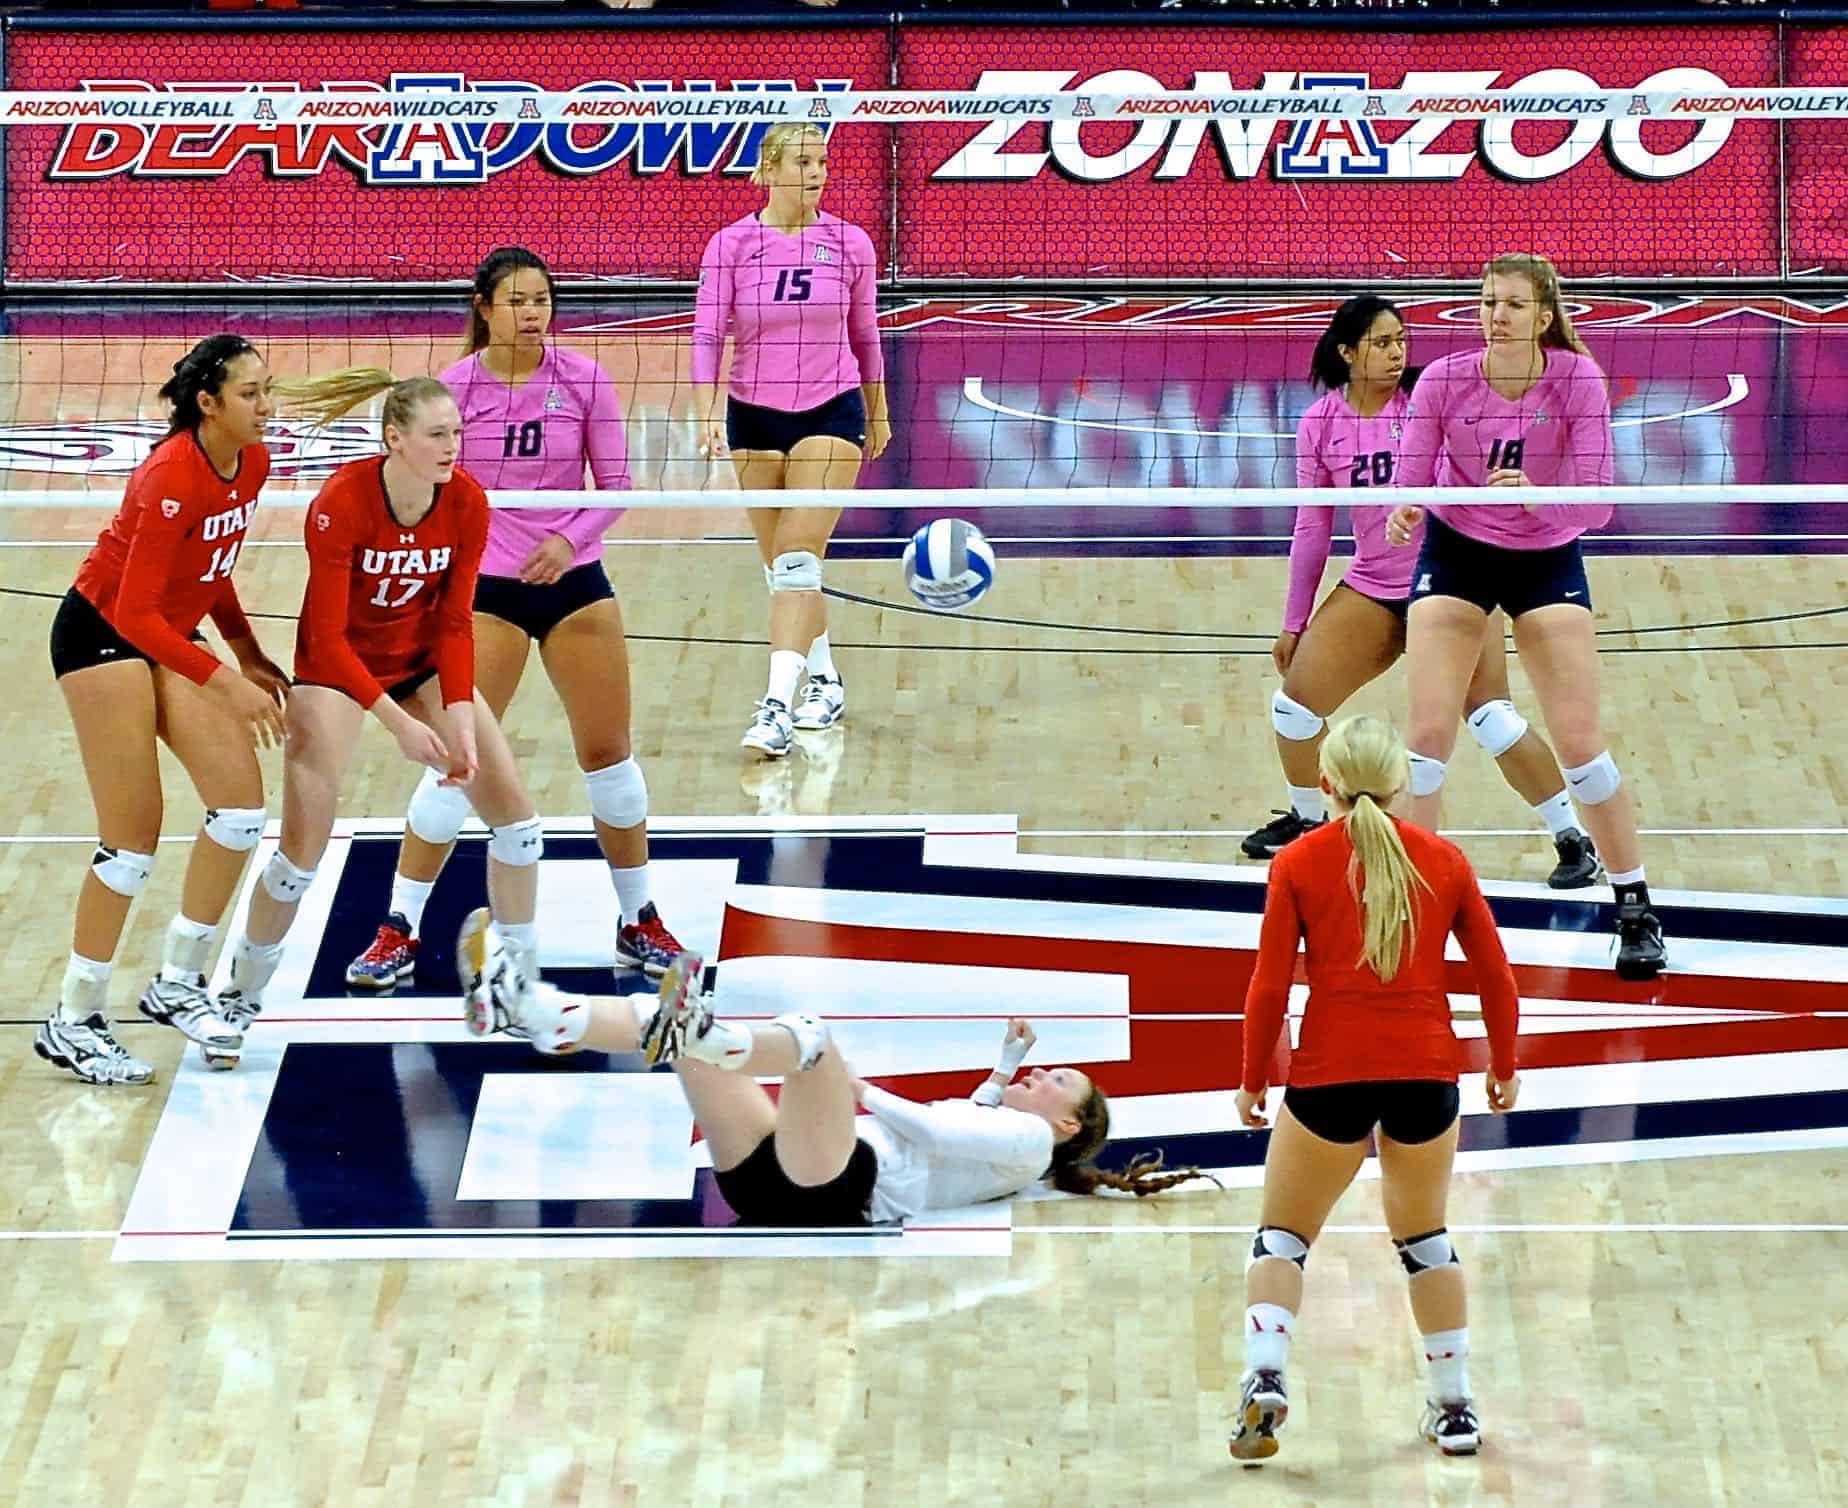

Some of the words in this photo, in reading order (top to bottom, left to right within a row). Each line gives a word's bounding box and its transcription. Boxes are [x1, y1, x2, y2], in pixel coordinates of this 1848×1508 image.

[1671, 96, 1848, 112] ARIZONAVOLLEY
[773, 269, 813, 302] 15
[504, 420, 542, 457] 10
[1487, 438, 1525, 471] 18
[1351, 450, 1392, 487] 20
[199, 541, 239, 581] 14
[362, 547, 452, 575] UTAH
[370, 577, 425, 608] 17
